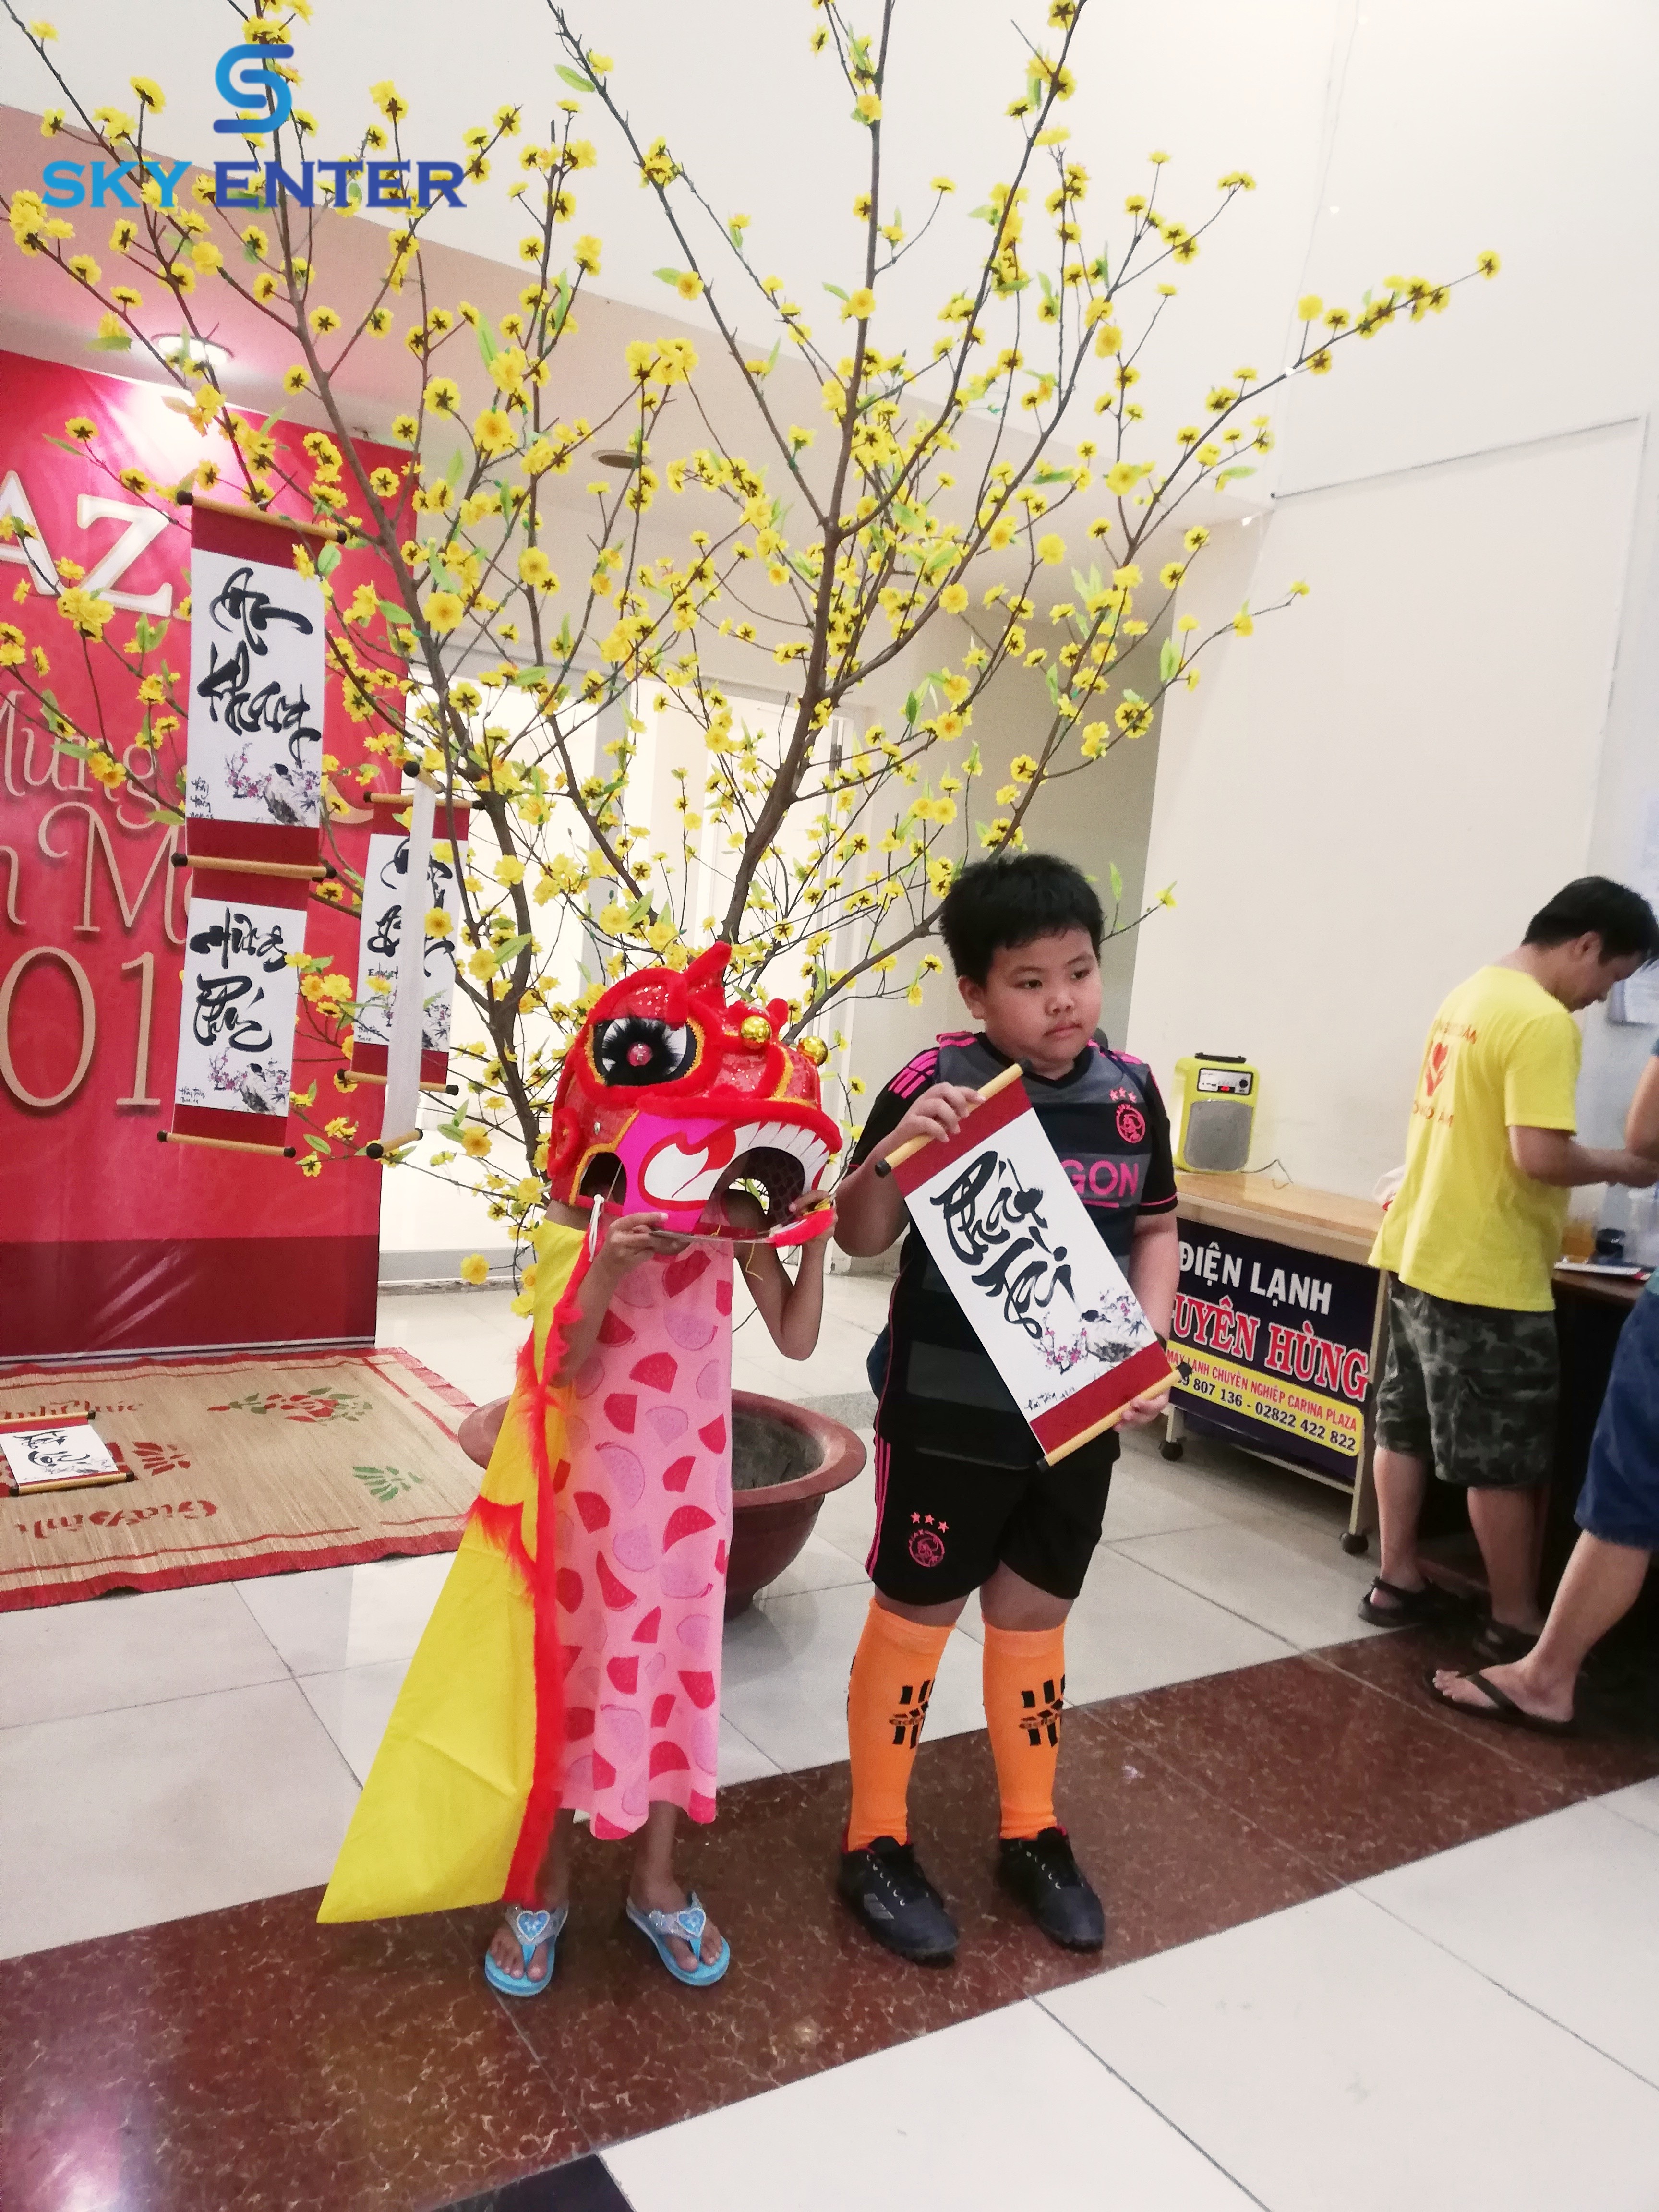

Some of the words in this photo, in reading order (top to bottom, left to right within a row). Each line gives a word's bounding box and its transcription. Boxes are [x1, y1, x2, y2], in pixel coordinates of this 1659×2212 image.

[0, 470, 191, 620] AZ
[1060, 1159, 1139, 1198] GON
[1178, 1241, 1243, 1288] ĐIỆN
[1250, 1262, 1332, 1315] LẠNH
[1171, 1292, 1261, 1362] UYÊN
[1264, 1320, 1370, 1402] HÙNG
[1193, 1378, 1216, 1396] 807
[1220, 1388, 1243, 1407] 136
[1255, 1401, 1297, 1428] 02822
[1300, 1419, 1326, 1440] 422
[1329, 1430, 1356, 1452] 822
[1288, 1395, 1323, 1420] CARINA
[1326, 1408, 1357, 1432] PLAZA
